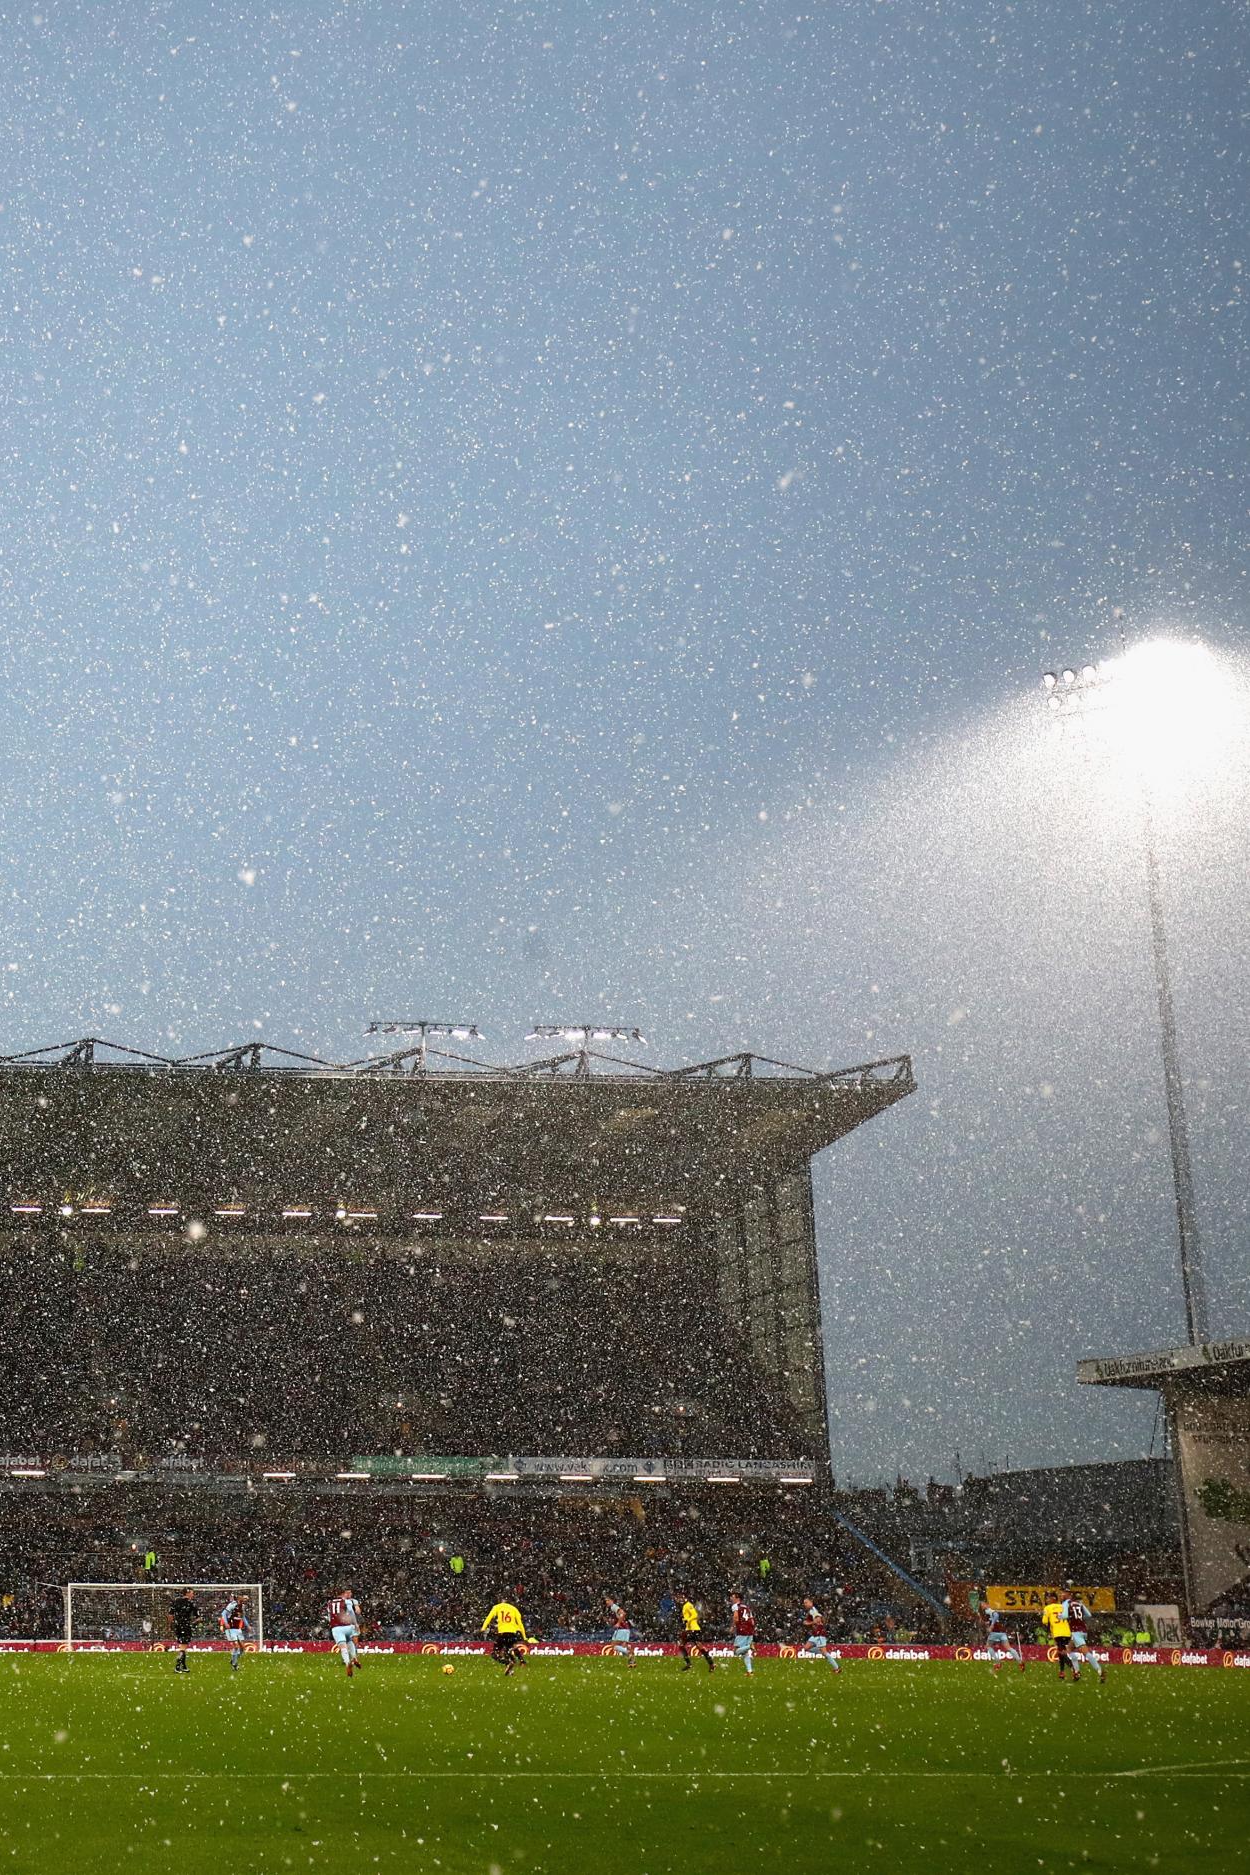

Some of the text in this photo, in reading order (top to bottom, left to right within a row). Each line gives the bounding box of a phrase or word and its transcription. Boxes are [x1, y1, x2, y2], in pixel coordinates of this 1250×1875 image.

[331, 1602, 341, 1614] 11
[1072, 1605, 1083, 1619] 13
[500, 1610, 512, 1623] 16
[742, 1609, 749, 1620] 4
[440, 1646, 485, 1654] dafabet
[530, 1647, 574, 1655] dafabet
[885, 1649, 929, 1660] dafabet
[1132, 1650, 1157, 1663] dafabet
[1181, 1652, 1207, 1665] dafabet
